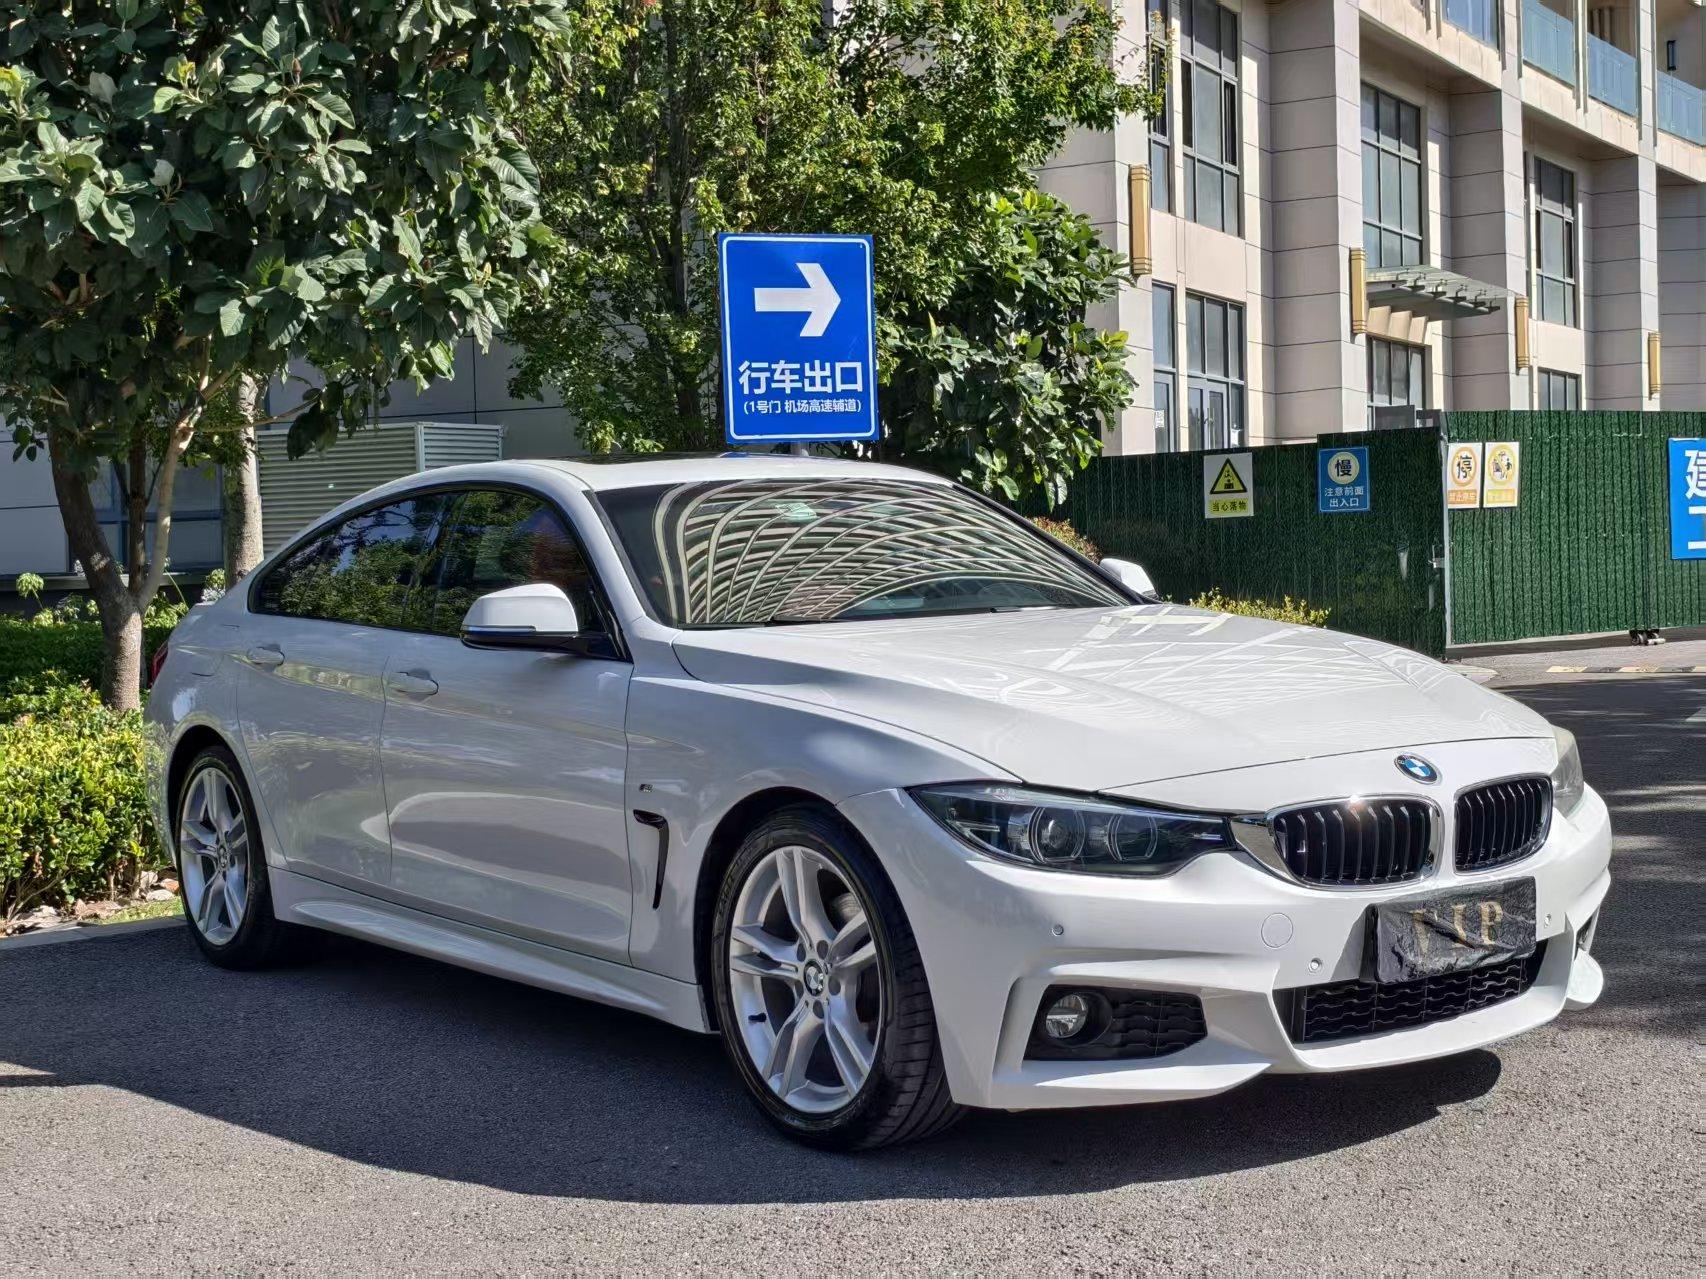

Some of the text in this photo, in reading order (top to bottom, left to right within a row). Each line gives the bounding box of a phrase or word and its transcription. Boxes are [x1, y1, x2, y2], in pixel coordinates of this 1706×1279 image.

[738, 359, 863, 395] 行车出口
[743, 400, 781, 414] (1号门
[1335, 459, 1352, 477] 慢
[1456, 455, 1472, 479] 停
[1324, 486, 1364, 497] 注意前面
[1212, 500, 1247, 511] 当心落物
[1329, 498, 1359, 507] 出入口
